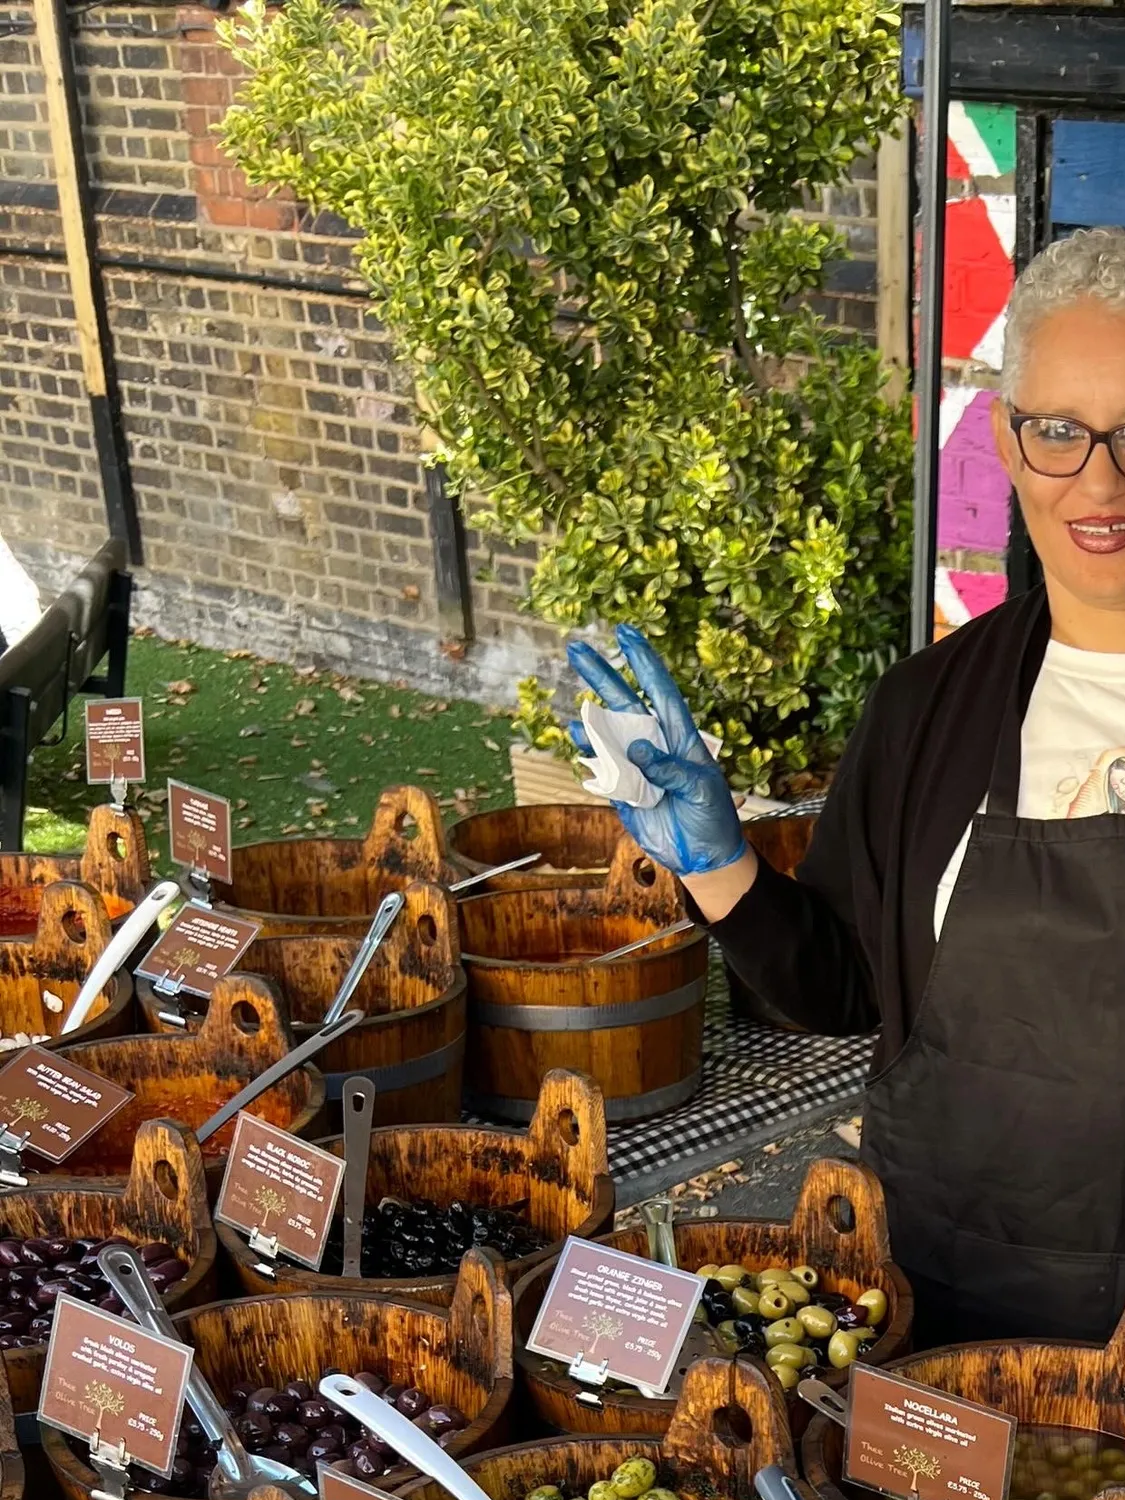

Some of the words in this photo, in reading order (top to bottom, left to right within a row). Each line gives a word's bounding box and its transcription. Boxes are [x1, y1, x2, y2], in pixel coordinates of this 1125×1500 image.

[36, 1063, 64, 1080] BUTTER
[266, 1142, 286, 1158] BLACK
[596, 1264, 631, 1282] ORANGE
[630, 1275, 663, 1292] ZINGER
[109, 1334, 135, 1354] VOLOS
[904, 1399, 958, 1425] NOCELLARA
